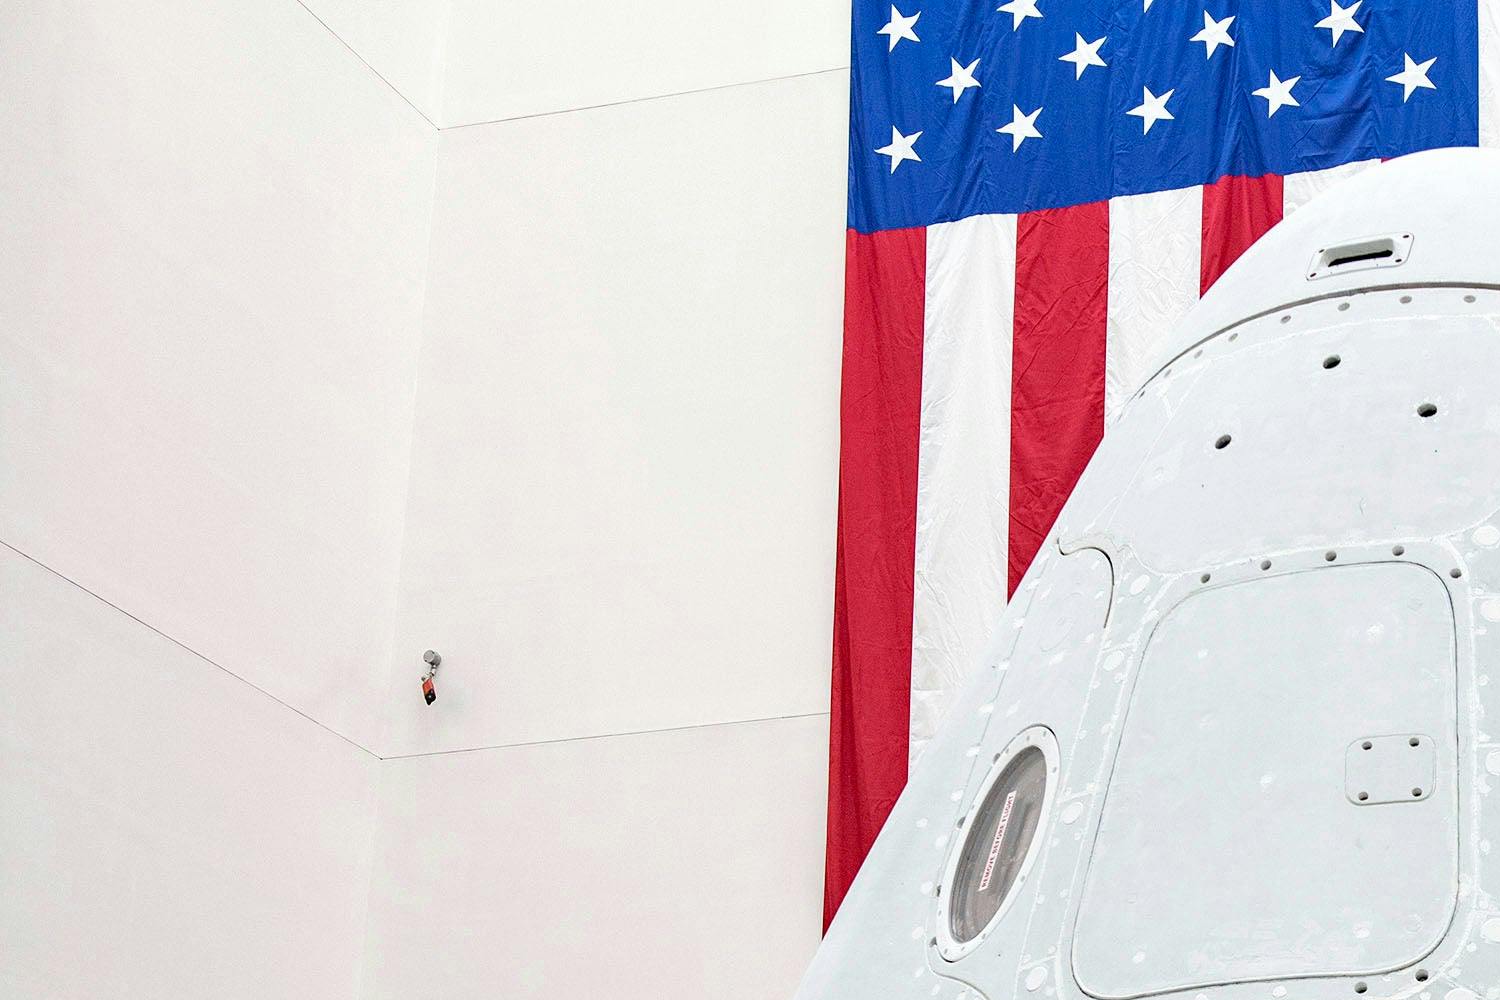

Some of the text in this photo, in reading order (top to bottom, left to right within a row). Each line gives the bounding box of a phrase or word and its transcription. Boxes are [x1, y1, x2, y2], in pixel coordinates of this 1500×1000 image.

[982, 796, 1013, 888] REMOVE BEFORE FLIGHT
